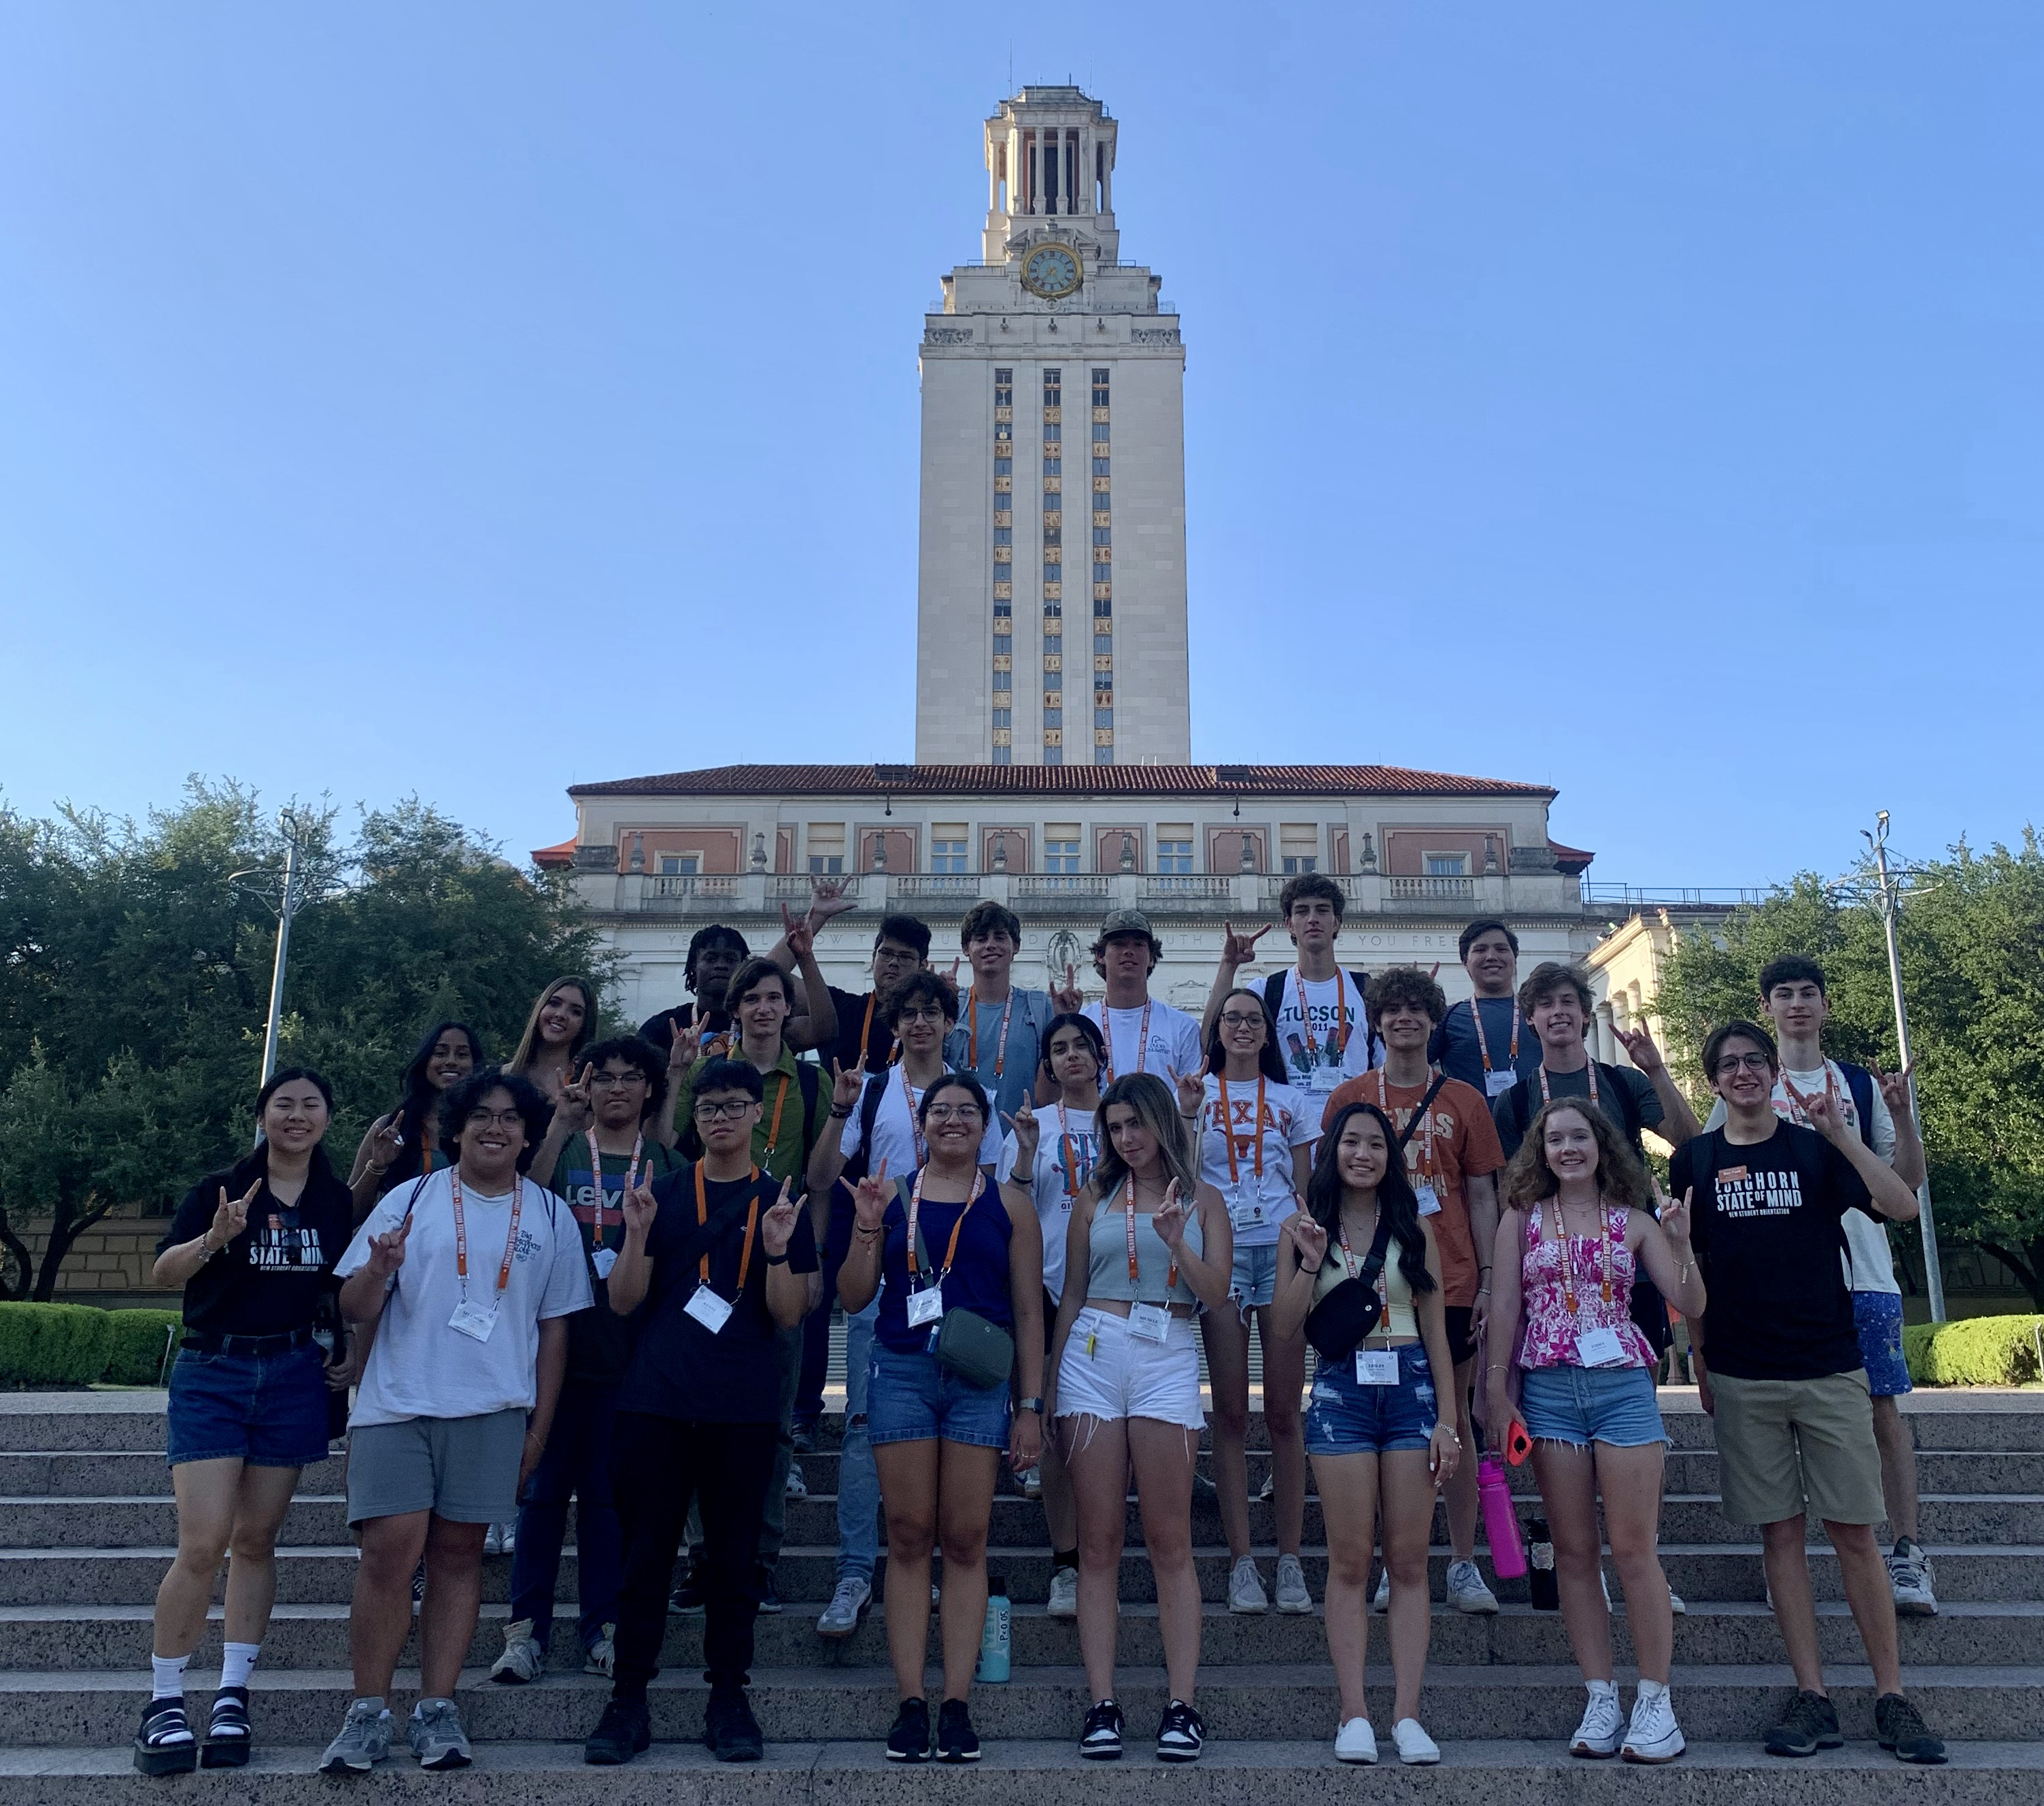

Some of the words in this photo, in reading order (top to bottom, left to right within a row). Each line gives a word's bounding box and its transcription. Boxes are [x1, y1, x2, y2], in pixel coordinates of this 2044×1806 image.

[1358, 936, 1396, 947] YOU
[1412, 936, 1460, 947] FREE
[1312, 1023, 1329, 1032] 011
[1715, 1172, 1800, 1194] LONGHORN
[566, 1185, 623, 1209] Lev
[1717, 1191, 1755, 1212] STATE
[1754, 1191, 1766, 1202] OF
[1766, 1190, 1803, 1208] MIND
[1739, 1209, 1759, 1217] STUDENT
[249, 1246, 290, 1265] STATE
